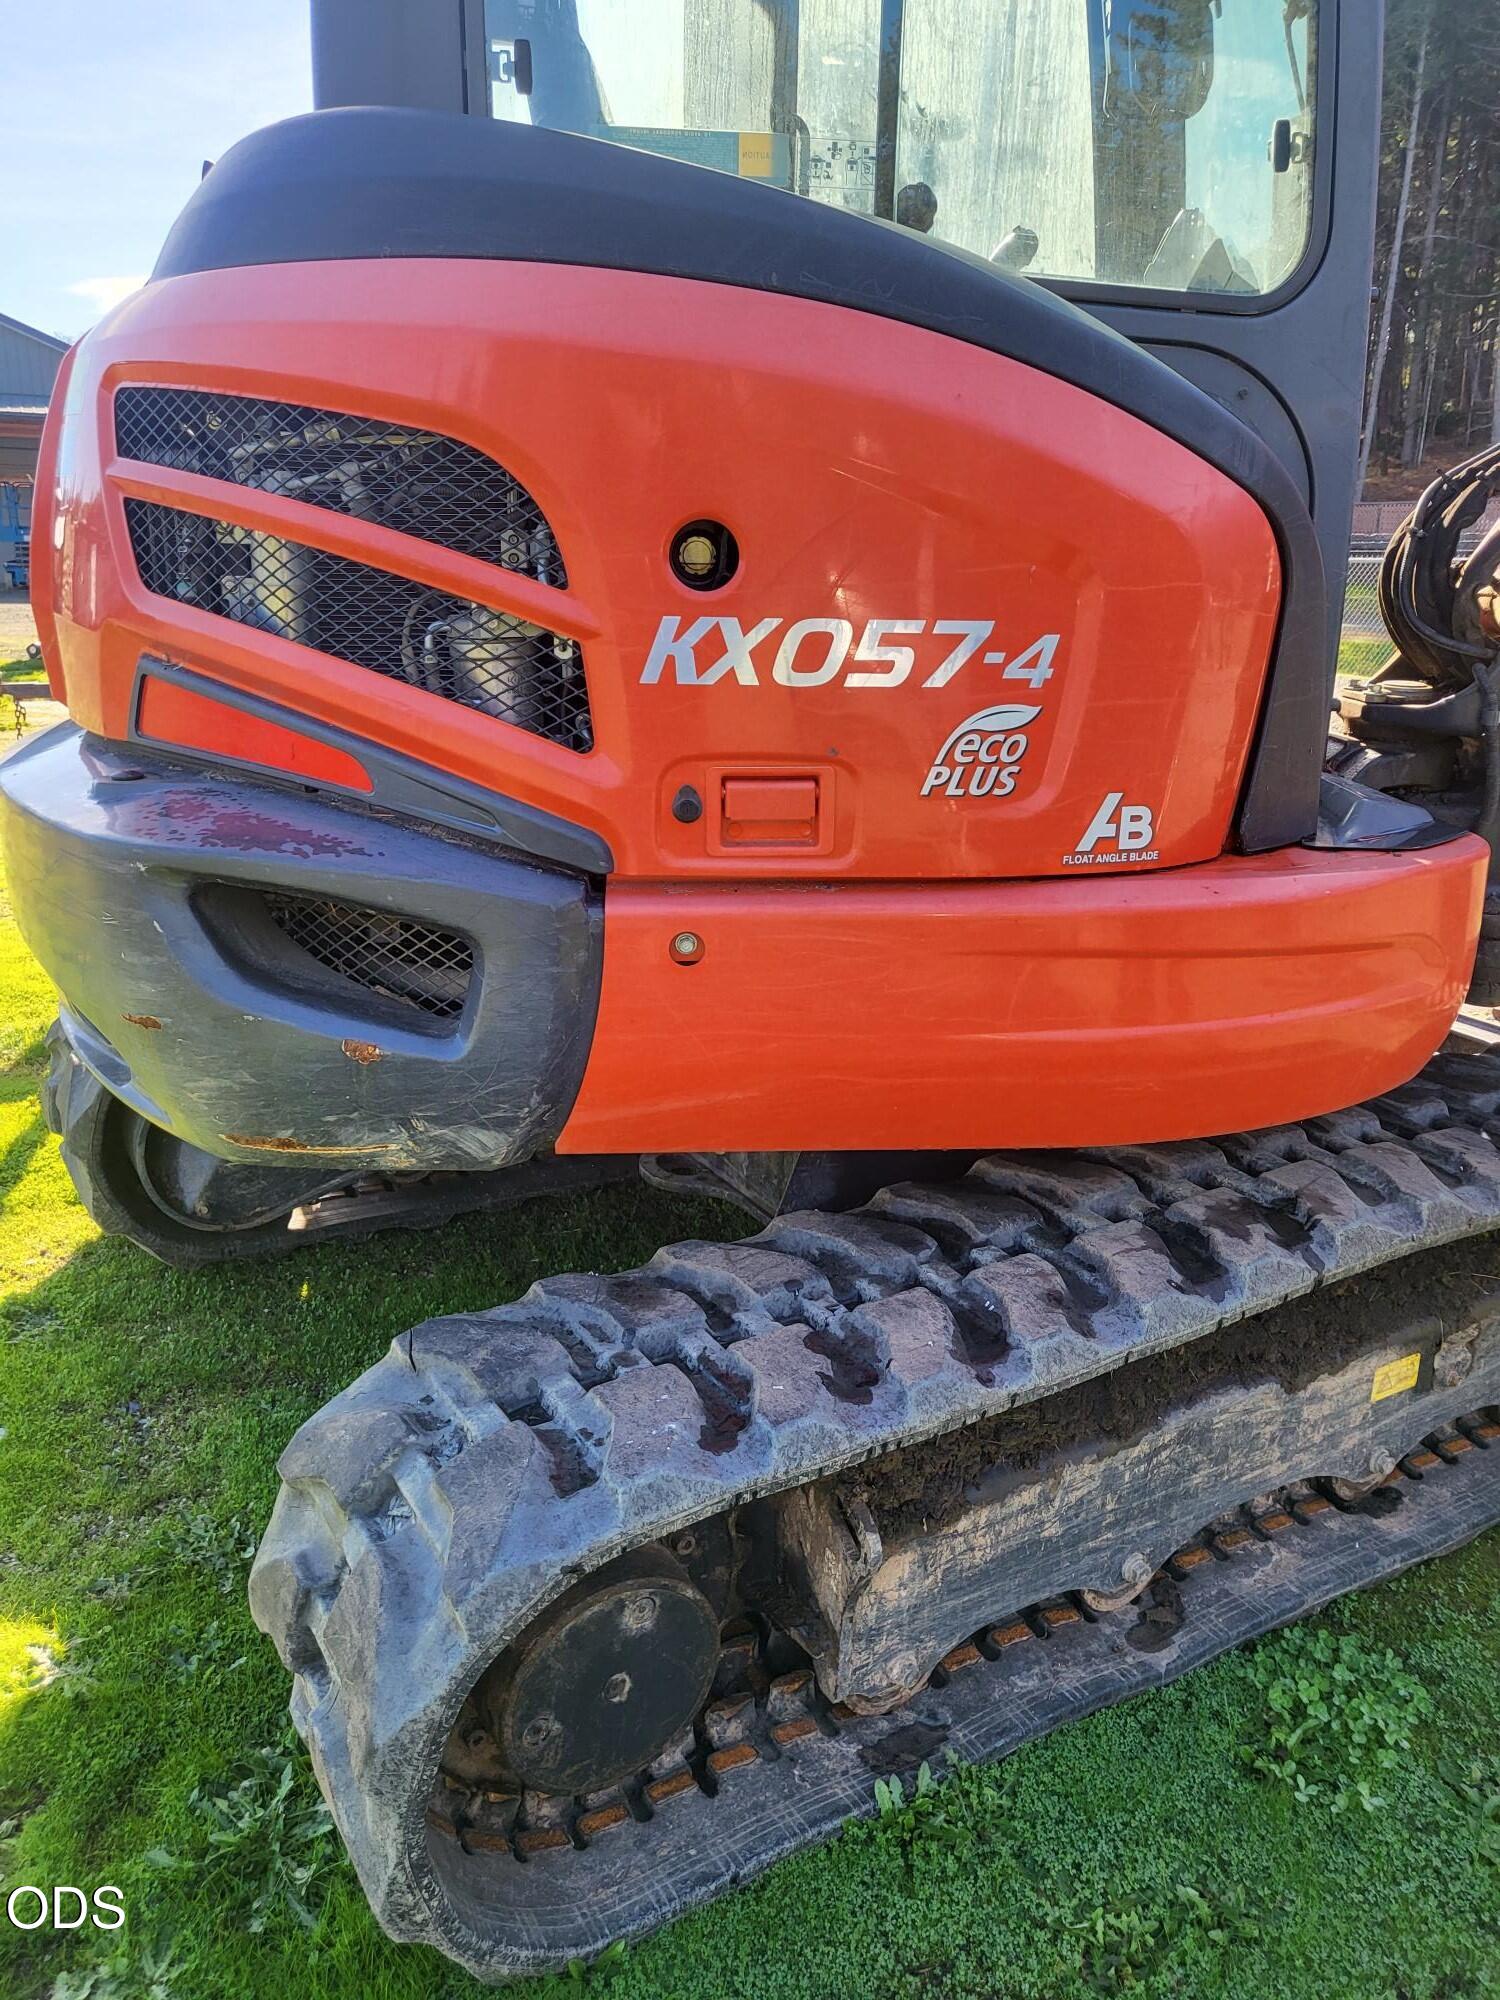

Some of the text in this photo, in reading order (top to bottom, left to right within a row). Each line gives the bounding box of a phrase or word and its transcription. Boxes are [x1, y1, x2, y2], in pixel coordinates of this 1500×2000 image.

[640, 615, 1060, 689] KX057-4
[954, 733, 1028, 763] eco
[920, 766, 1021, 796] PLUS
[1075, 793, 1153, 852] AB
[1063, 851, 1159, 865] FLOAT ANGLE BLADE
